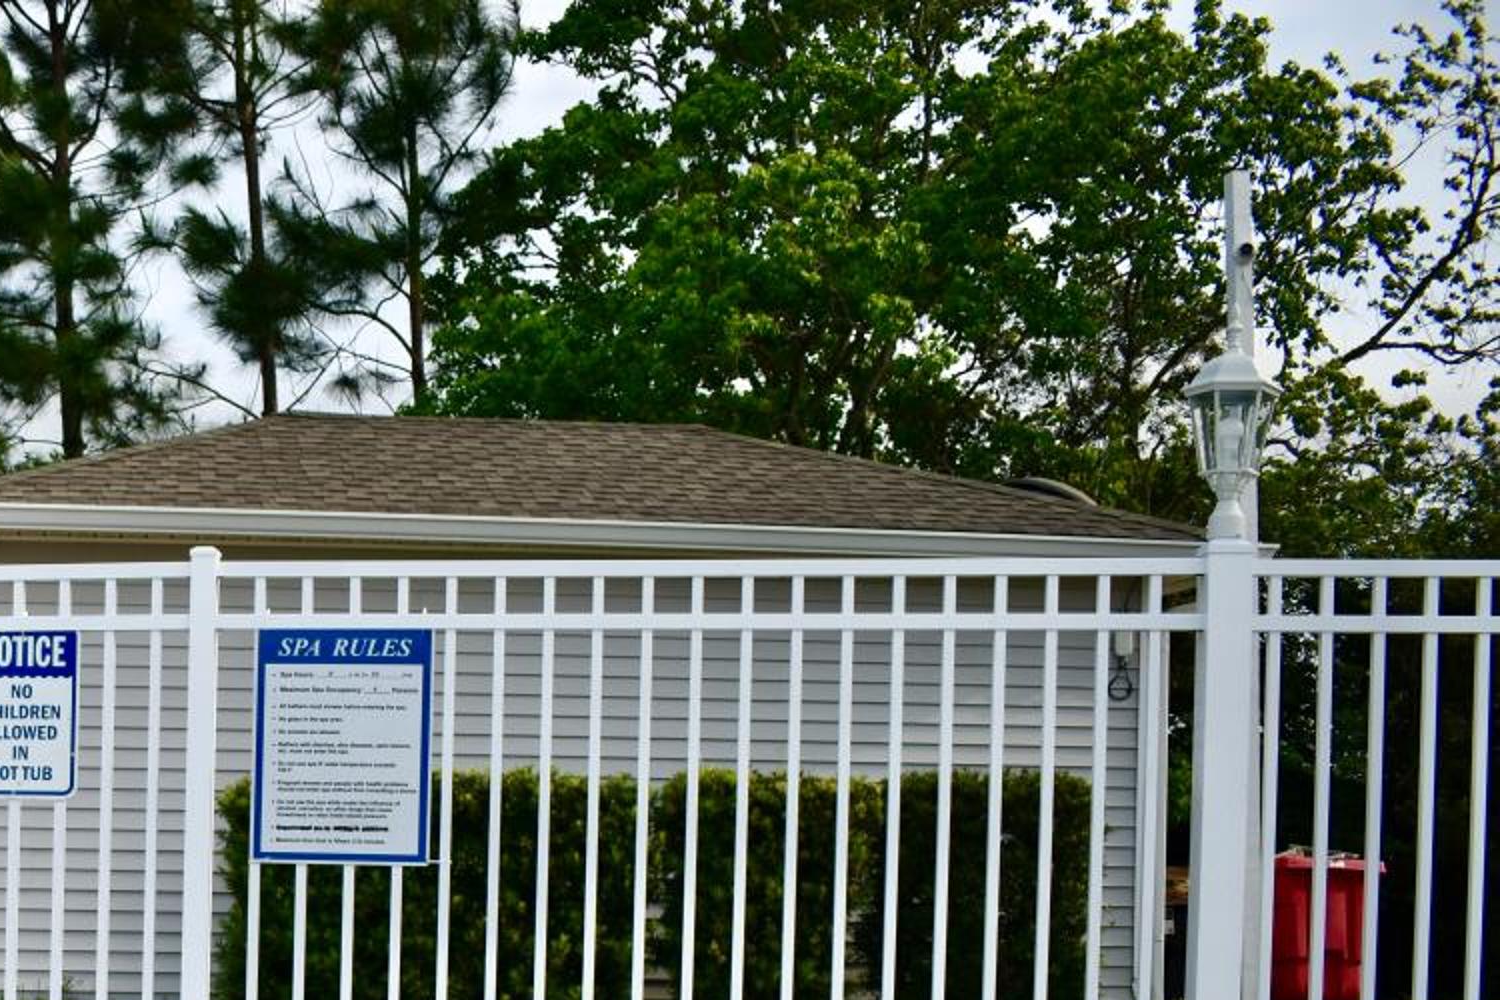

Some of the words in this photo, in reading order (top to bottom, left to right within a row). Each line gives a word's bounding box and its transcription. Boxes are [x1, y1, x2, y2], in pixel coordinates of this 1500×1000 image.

[278, 637, 321, 657] SPA
[333, 638, 412, 657] RULES
[11, 684, 33, 699] NO
[13, 746, 28, 760] IN
[22, 766, 53, 780] TUB
